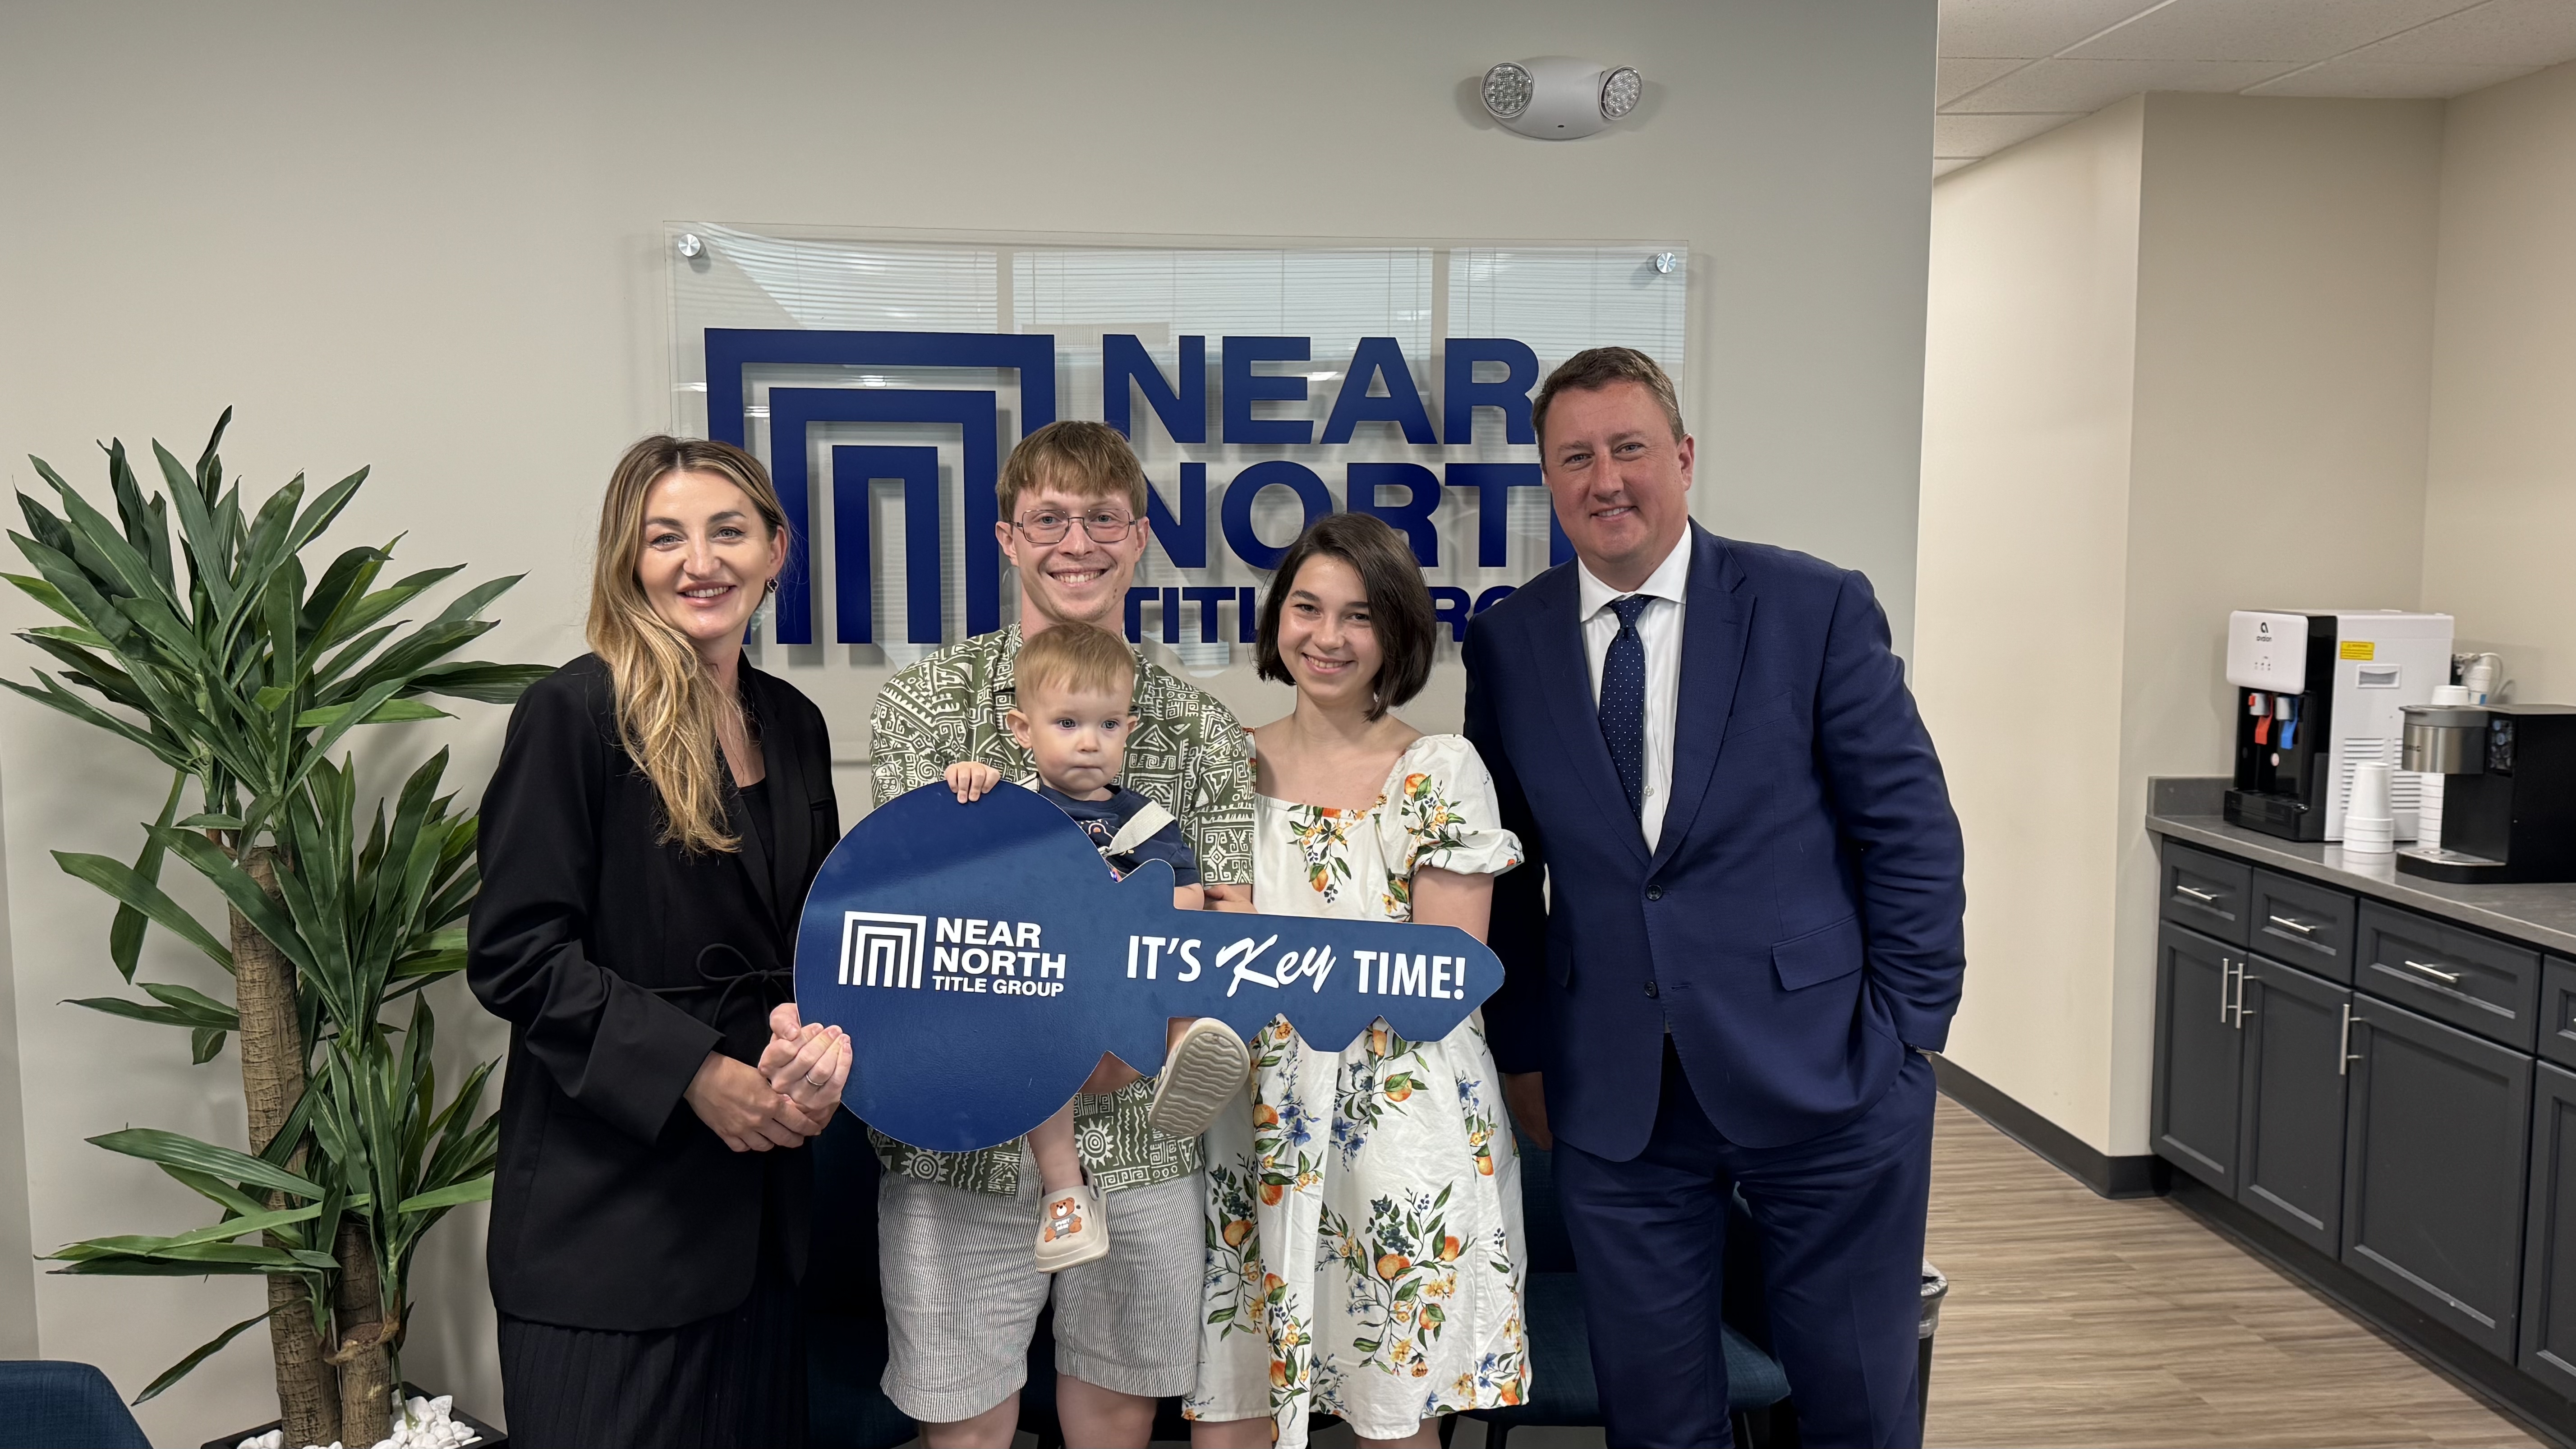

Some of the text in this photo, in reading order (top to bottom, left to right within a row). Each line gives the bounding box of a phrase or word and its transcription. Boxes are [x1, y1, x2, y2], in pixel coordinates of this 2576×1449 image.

[1103, 334, 1539, 445] NEAR
[1144, 460, 1578, 568] NORT
[1124, 587, 1256, 644] TITL
[935, 916, 1042, 949] NEAR
[932, 975, 1064, 998] TITLE GROUP
[933, 946, 1067, 980] NORTH
[1127, 934, 1466, 1001] IT'S Key TIME!
